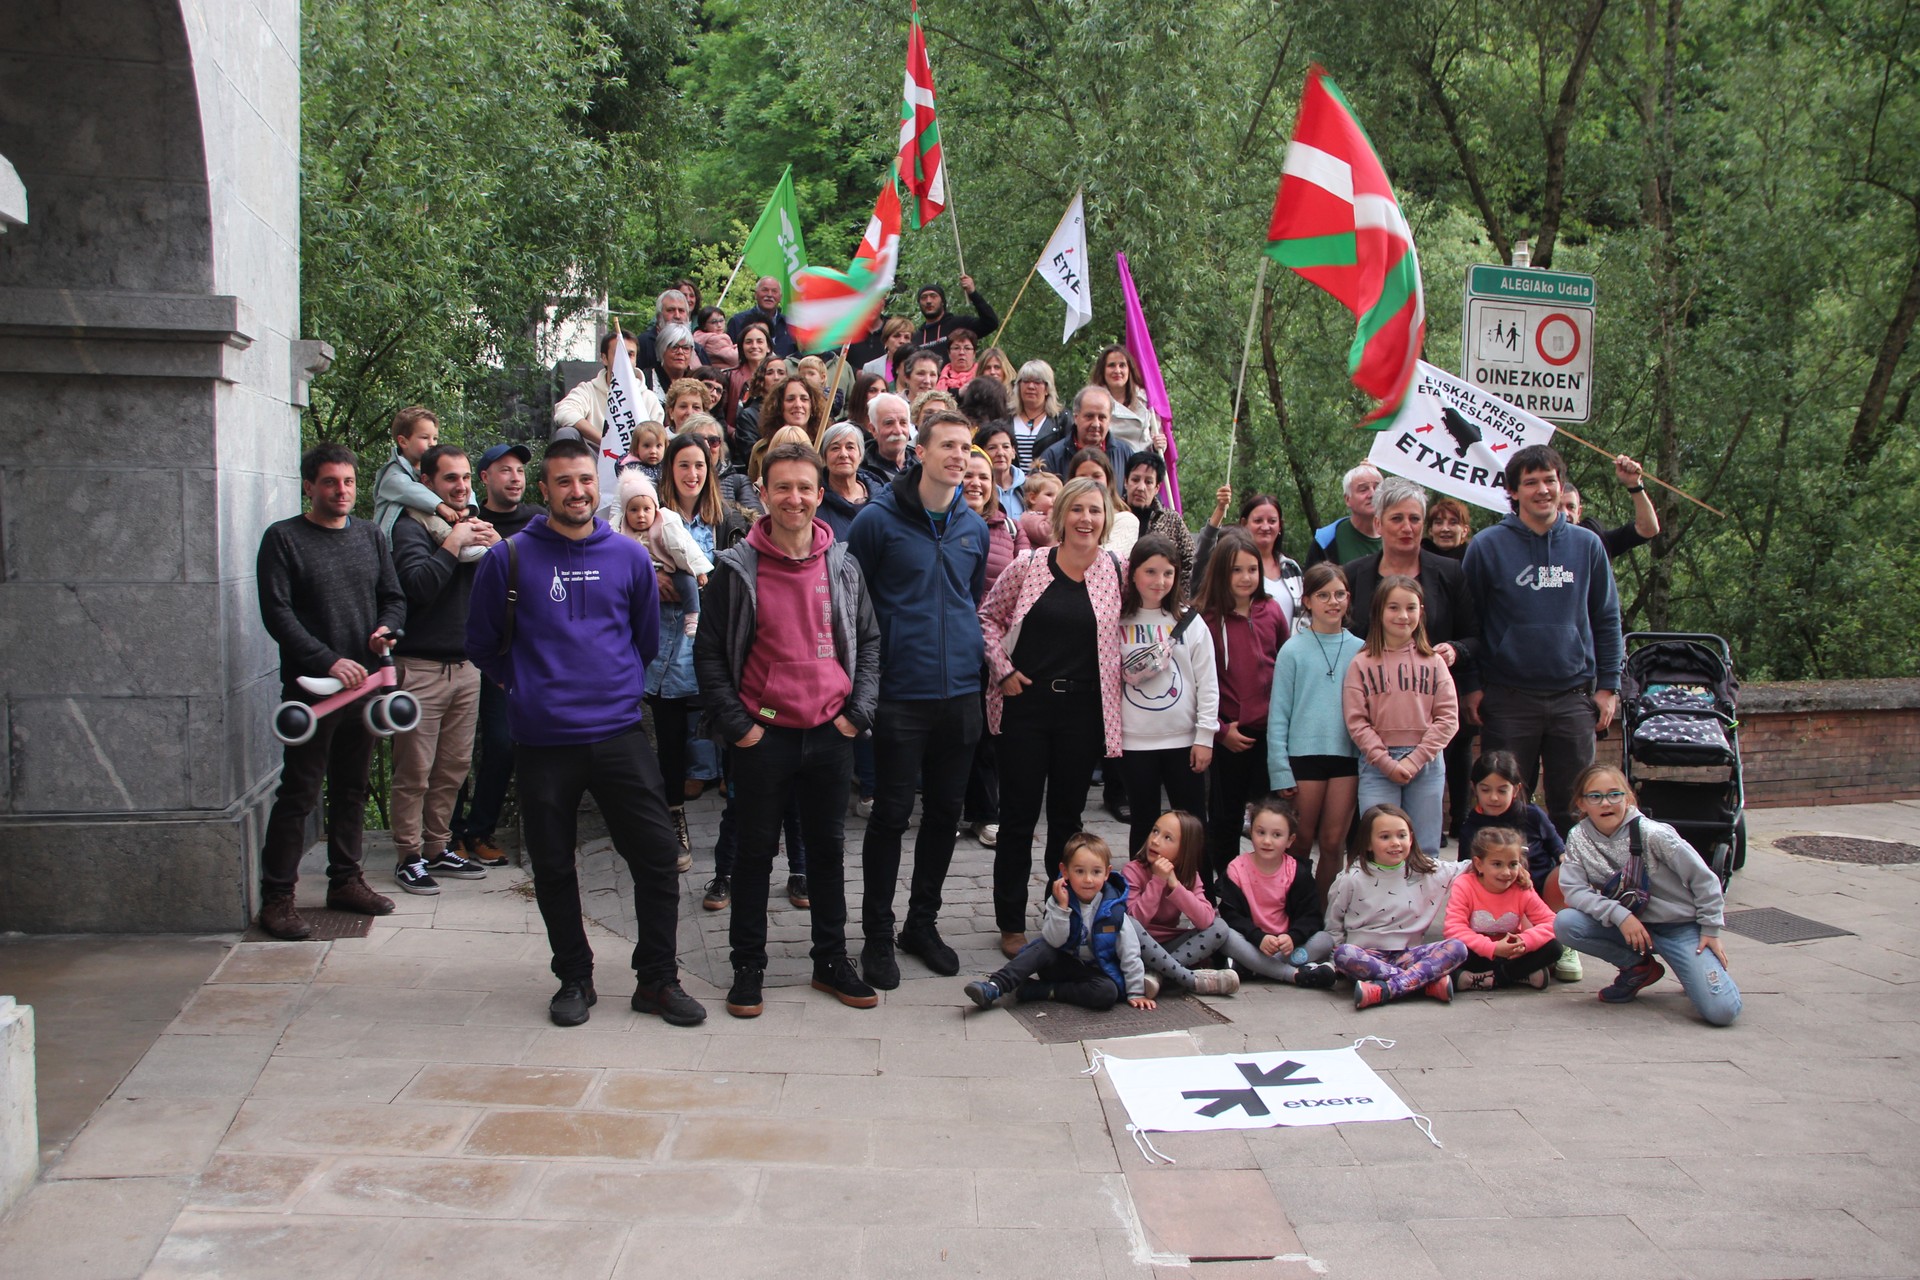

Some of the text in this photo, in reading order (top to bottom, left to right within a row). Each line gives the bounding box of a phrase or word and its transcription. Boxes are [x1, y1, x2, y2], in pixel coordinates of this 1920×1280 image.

[1500, 277, 1590, 297] ALEGIAko Udala
[1476, 367, 1581, 390] OINEZKOEN
[1418, 384, 1441, 398] ETA
[1425, 375, 1526, 433] EUSKAL PRESO
[1492, 392, 1575, 413] PARRUA
[1395, 431, 1508, 491] ETXERA
[1119, 623, 1185, 645] NIRVA
[1283, 1097, 1374, 1109] etxera
